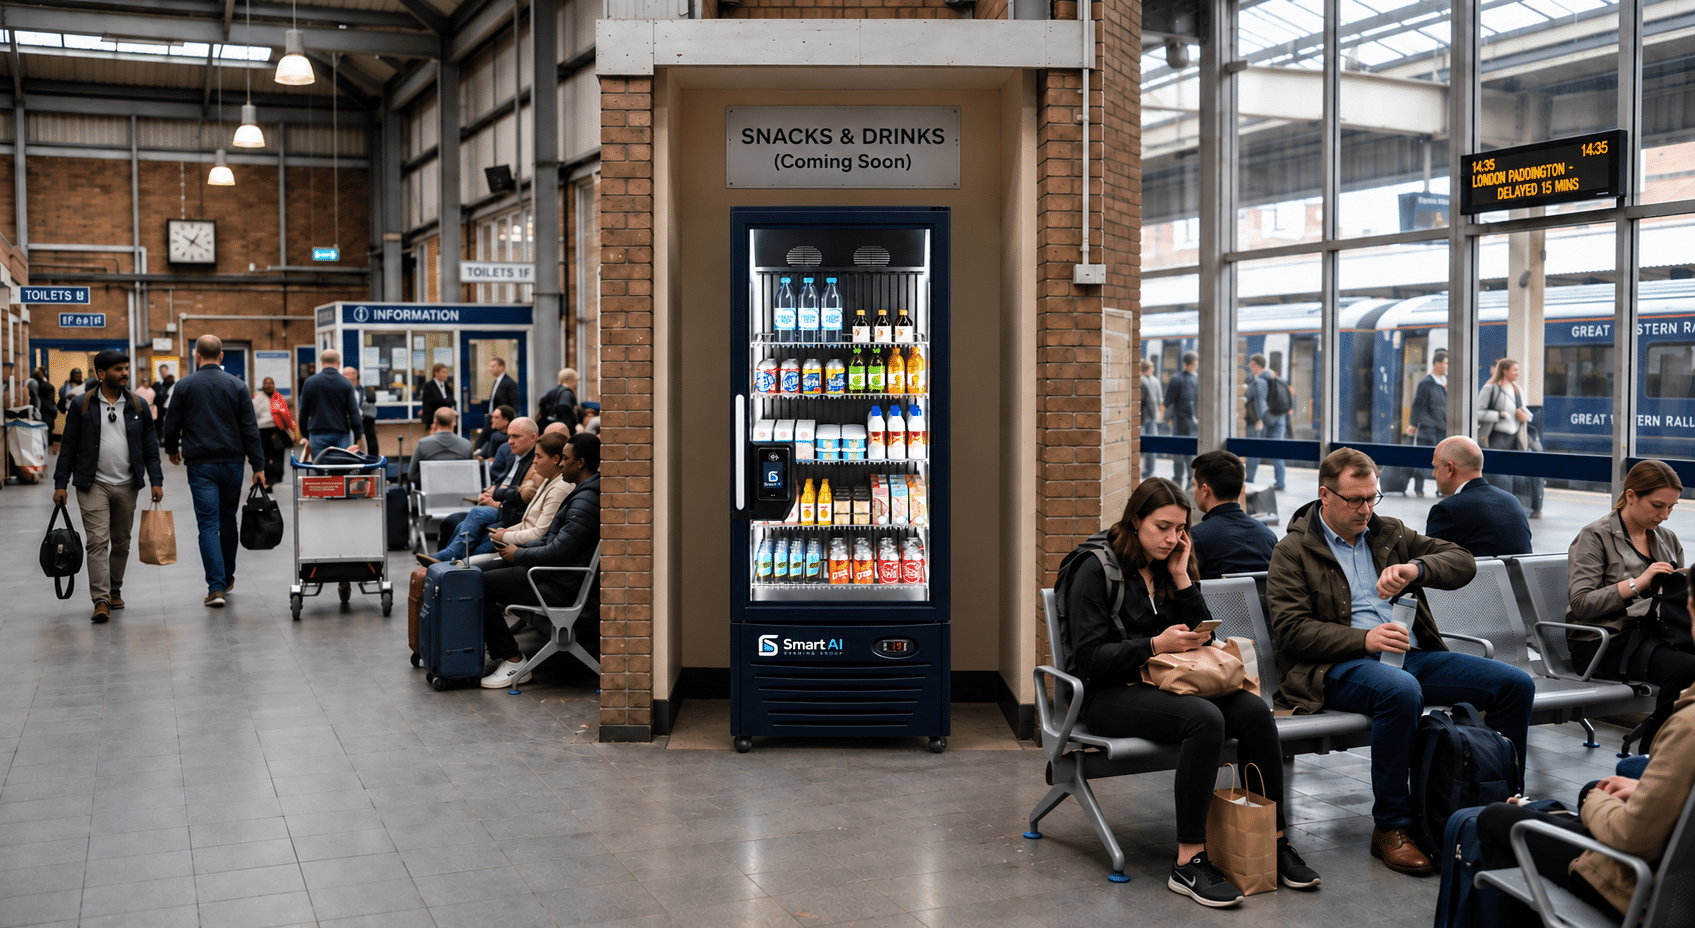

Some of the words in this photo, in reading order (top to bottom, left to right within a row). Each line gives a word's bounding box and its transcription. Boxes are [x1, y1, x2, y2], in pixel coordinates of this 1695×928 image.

[741, 127, 833, 145] SNACKS
[840, 127, 855, 145] &
[862, 127, 945, 145] DRINKS
[774, 153, 853, 173] (Coming
[857, 153, 912, 172] Soon)
[1472, 171, 1506, 188] LONDON
[1508, 162, 1566, 183] PADDINGTON
[1497, 182, 1538, 200] DELAYED
[1541, 181, 1552, 194] 15
[1555, 177, 1579, 192] MINS
[466, 266, 515, 278] TOILETS
[518, 267, 531, 278] 1F
[25, 289, 73, 301] TOILETS
[373, 309, 460, 321] INFORMATION
[1571, 324, 1611, 338] GREAT
[1636, 322, 1678, 336] STERN
[1570, 413, 1607, 425] GREAT
[783, 638, 827, 651] Smart
[827, 638, 843, 650] AI
